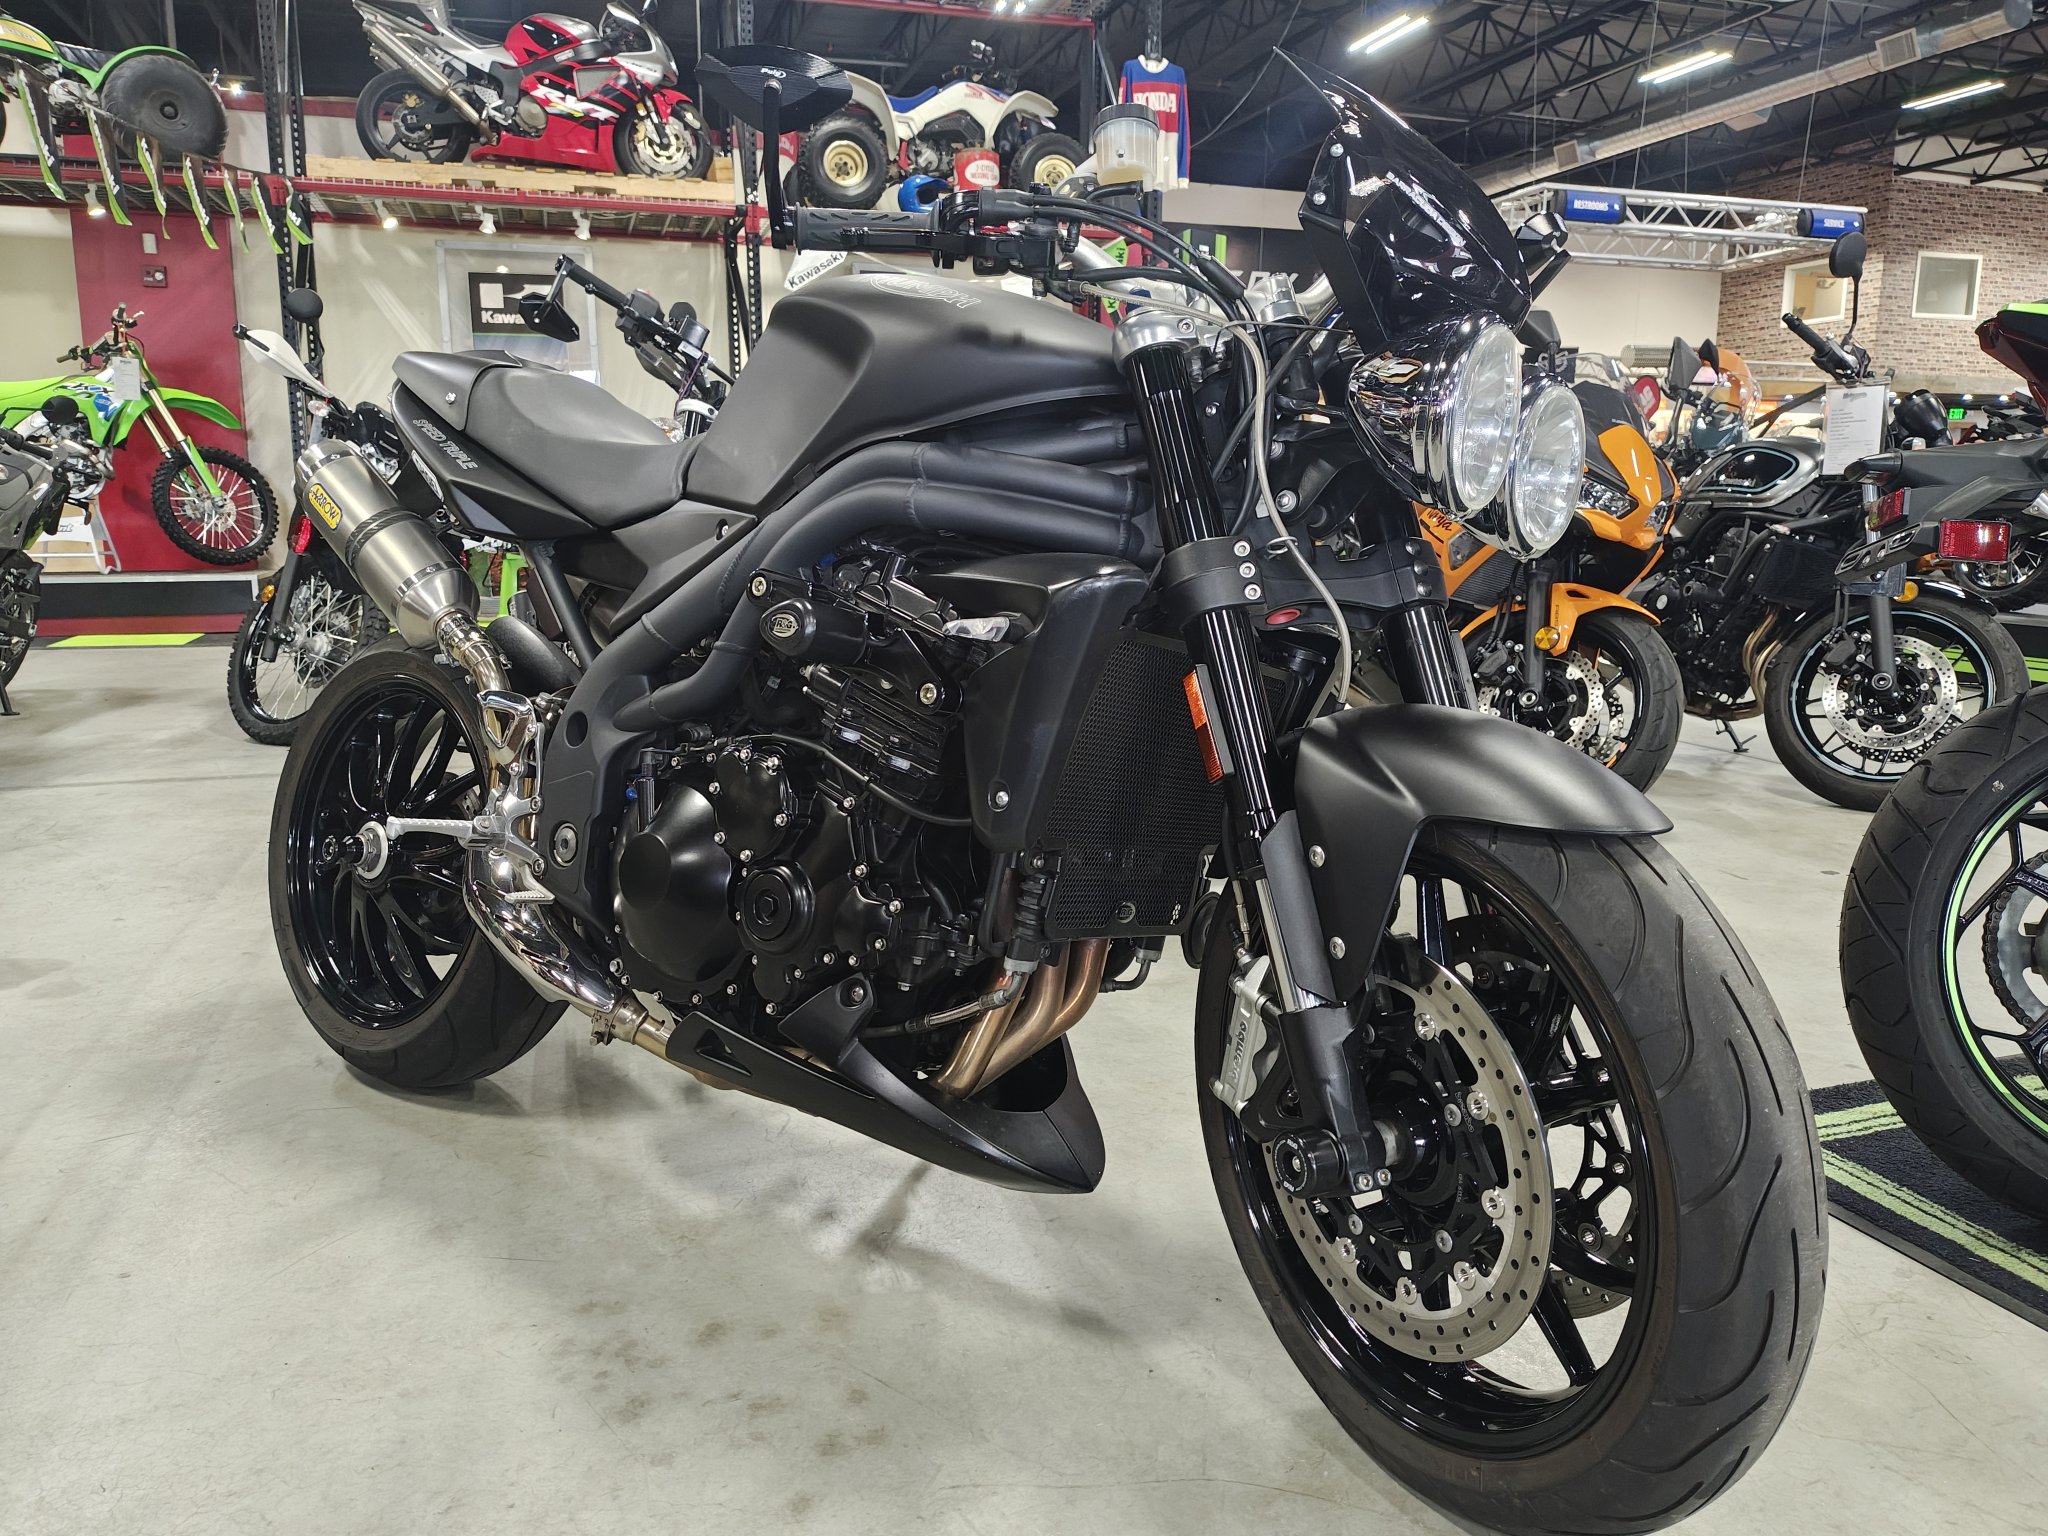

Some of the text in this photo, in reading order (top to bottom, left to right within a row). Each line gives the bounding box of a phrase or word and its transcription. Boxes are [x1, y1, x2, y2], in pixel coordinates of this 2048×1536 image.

[1385, 171, 1438, 220] BARRACUDA
[1574, 199, 1609, 211] RESTROOMS
[1824, 218, 1845, 228] SERVICE
[788, 252, 844, 289] Kawasaki
[480, 310, 526, 325] Kawa
[412, 418, 479, 470] SPEED TRIPLE
[310, 487, 341, 521] ARROW
